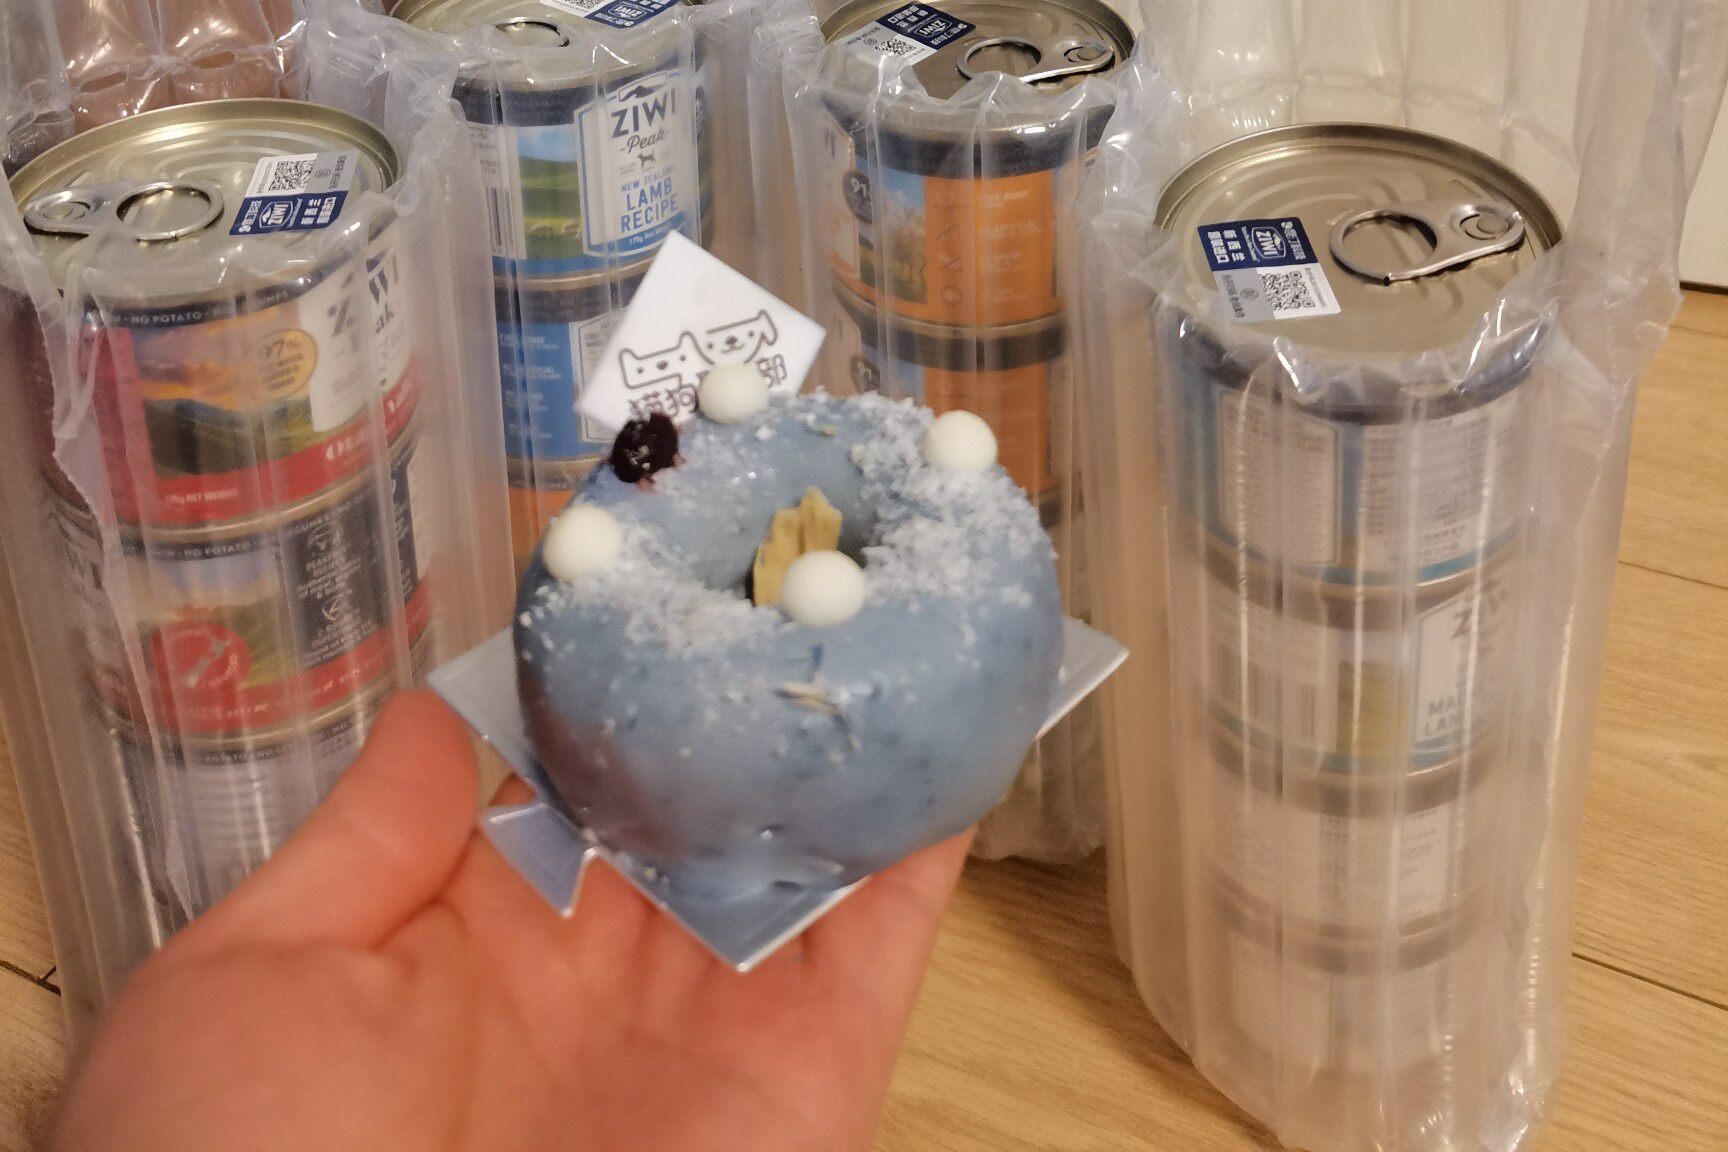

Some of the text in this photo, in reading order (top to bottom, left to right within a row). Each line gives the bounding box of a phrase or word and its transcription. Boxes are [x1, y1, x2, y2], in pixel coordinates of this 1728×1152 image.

[919, 19, 945, 36] ZIWI
[611, 87, 677, 138] ZIWI
[626, 126, 667, 154] Peak
[621, 179, 640, 193] NEW
[626, 176, 673, 212] LAMB
[267, 203, 289, 226] ZIWI
[620, 192, 678, 233] RECIPE
[1256, 230, 1280, 256] ZIWI
[153, 310, 202, 324] POTATO
